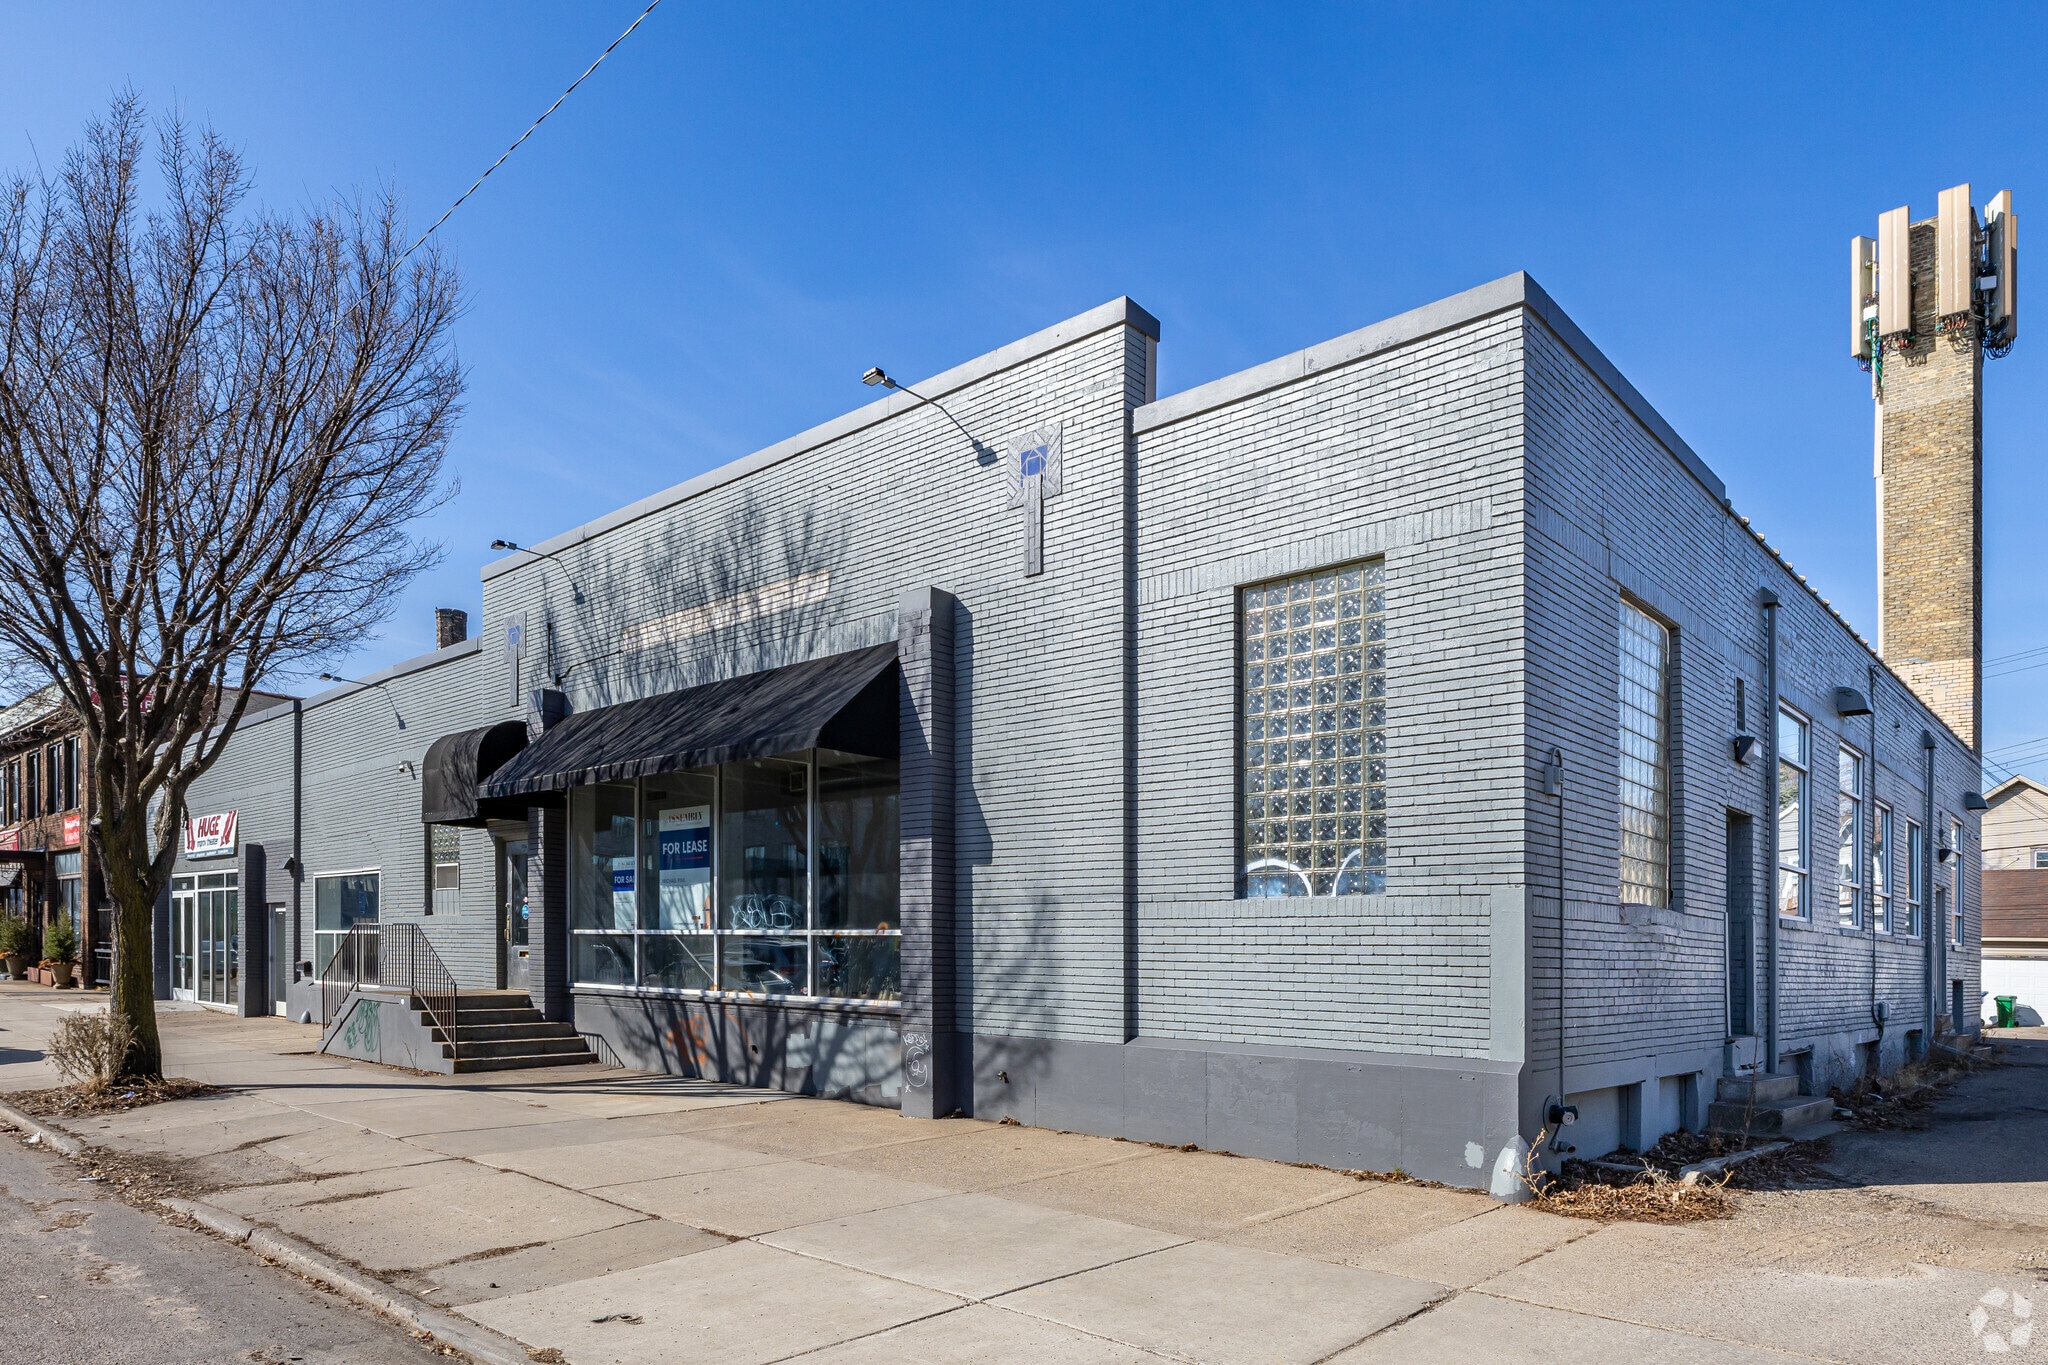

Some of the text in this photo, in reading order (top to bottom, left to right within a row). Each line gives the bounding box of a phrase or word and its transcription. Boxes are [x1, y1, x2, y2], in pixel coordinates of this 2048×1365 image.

[197, 815, 221, 838] HUGE
[662, 839, 708, 855] FOR LEASE
[614, 875, 635, 884] FOR SA
